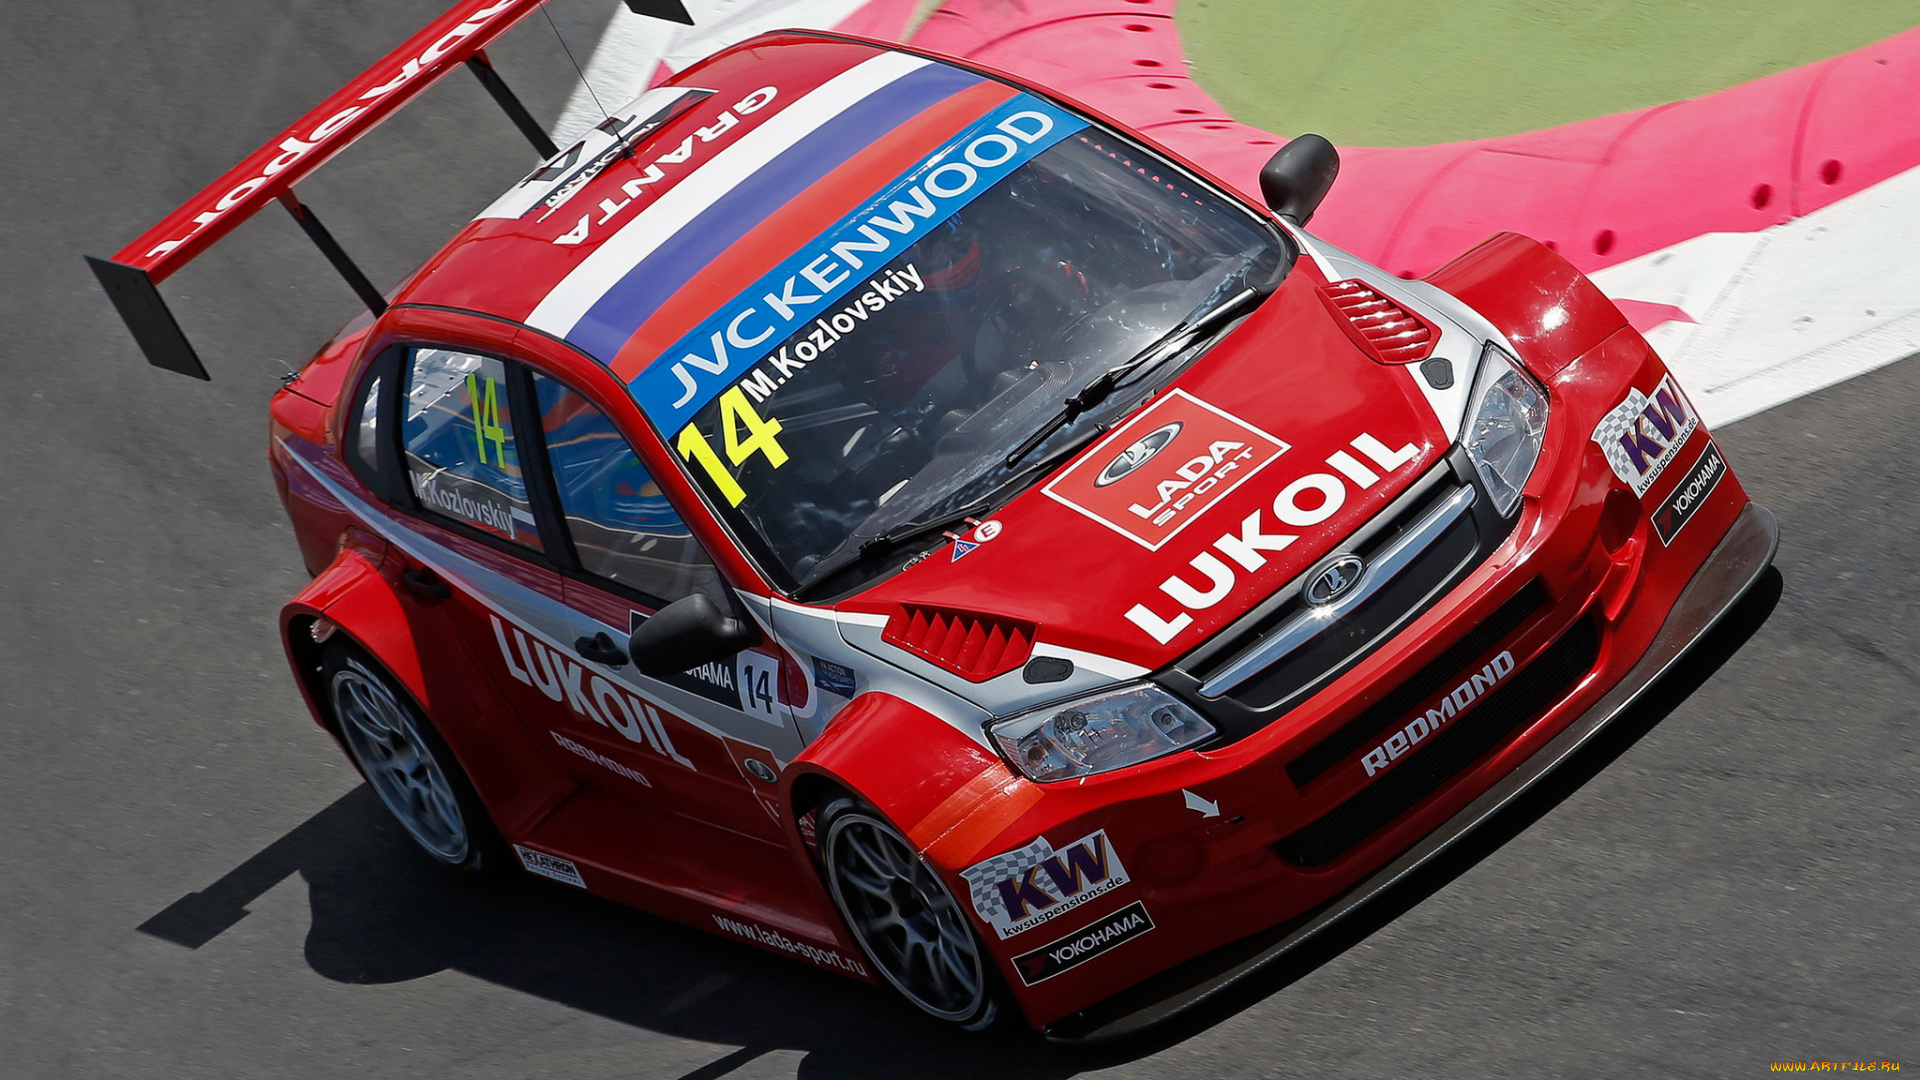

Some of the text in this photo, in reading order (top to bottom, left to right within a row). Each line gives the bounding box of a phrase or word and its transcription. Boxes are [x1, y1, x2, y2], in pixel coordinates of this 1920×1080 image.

[145, 105, 370, 258] sport
[552, 85, 779, 245] GRANTA
[739, 263, 926, 405] M.Kozlovskiy
[466, 373, 506, 470] 14
[677, 385, 790, 509] 14
[1619, 376, 1688, 477] KW
[1636, 416, 1697, 495] kwsuspensions.de
[1127, 440, 1246, 520] LADA
[1152, 446, 1254, 528] SPORT
[1672, 453, 1721, 516] YOKOHAMA
[980, 524, 996, 539] E
[1123, 432, 1422, 646] LUKOIL
[490, 614, 698, 773] LUKOIL
[744, 664, 773, 714] 14
[996, 832, 1111, 923] KW
[1002, 876, 1124, 938] kwsuspensions.de
[712, 914, 869, 977] www.lada-sport.ru
[1049, 912, 1145, 964] YOKOHAMA
